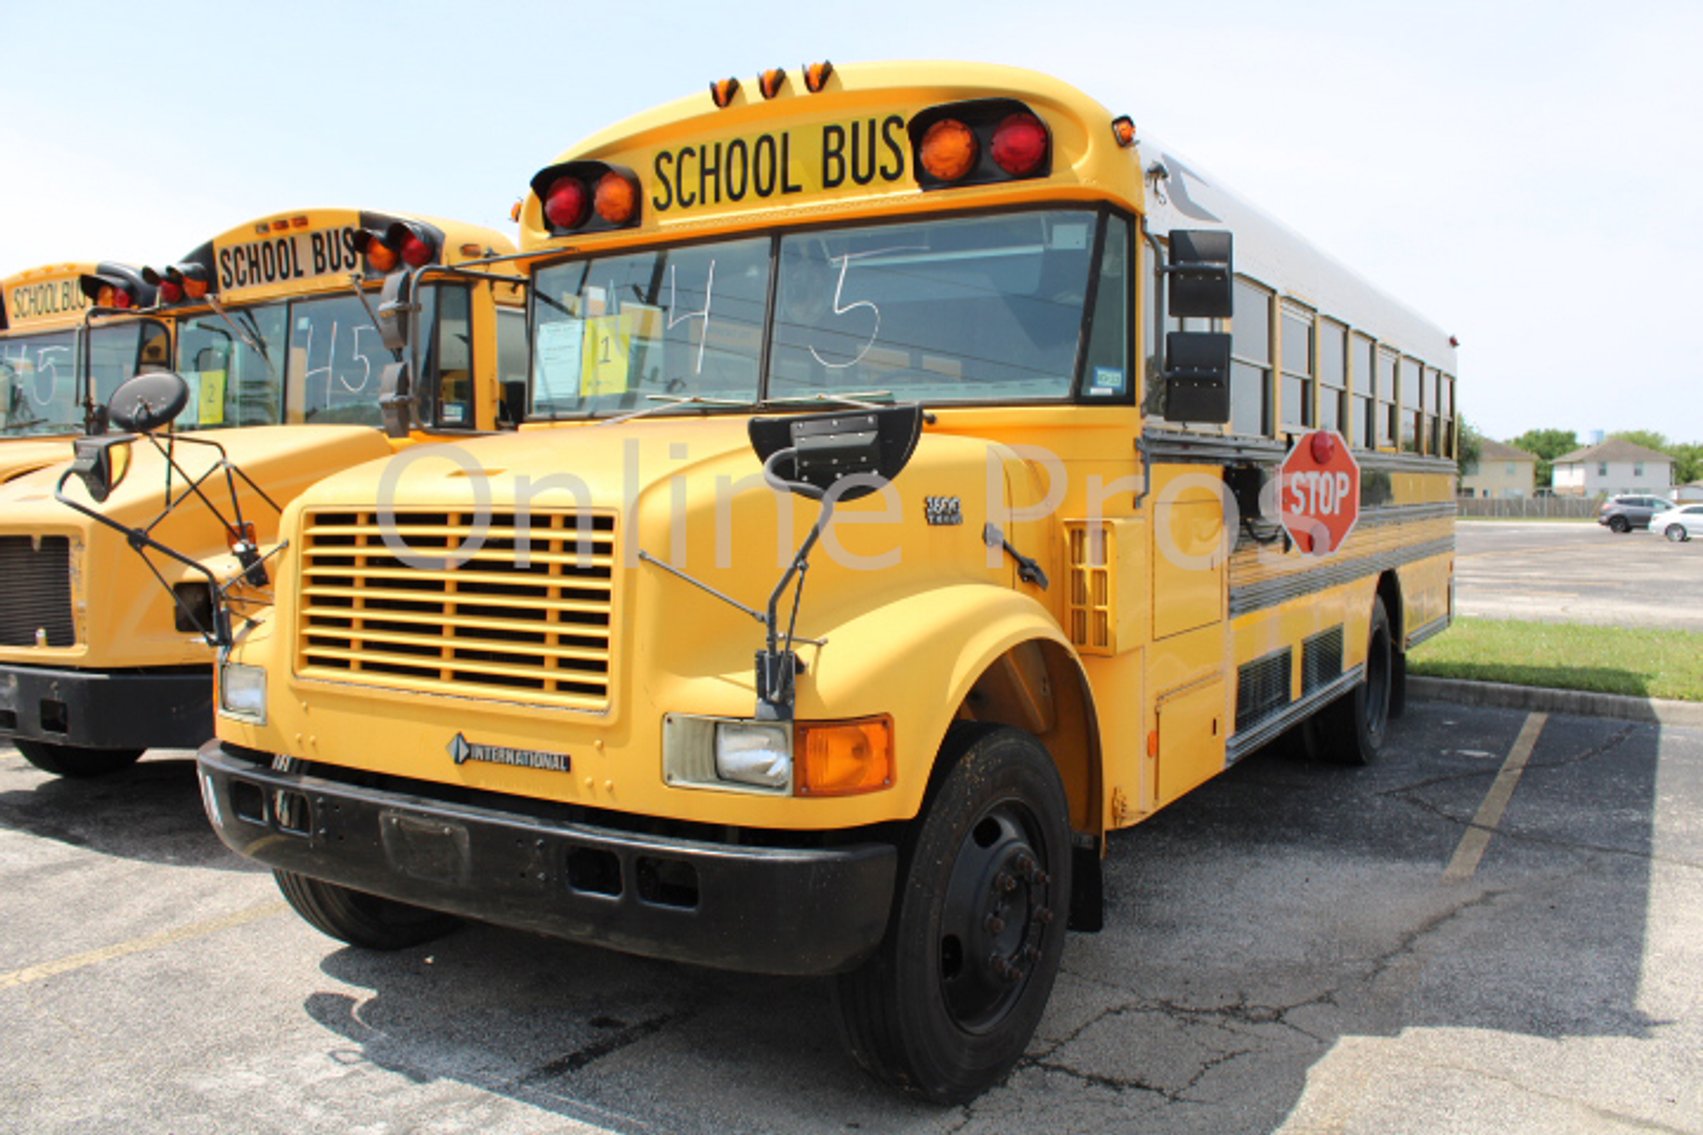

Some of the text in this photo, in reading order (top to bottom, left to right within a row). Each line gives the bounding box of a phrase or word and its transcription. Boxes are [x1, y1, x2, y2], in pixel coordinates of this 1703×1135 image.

[652, 114, 905, 212] SCHOOL BUS
[219, 226, 358, 290] SCHOOL BUS
[13, 282, 59, 318] SCHOOL
[598, 336, 613, 365] 1
[1290, 470, 1350, 516] STOP
[470, 745, 568, 772] INTERNATIONAL
